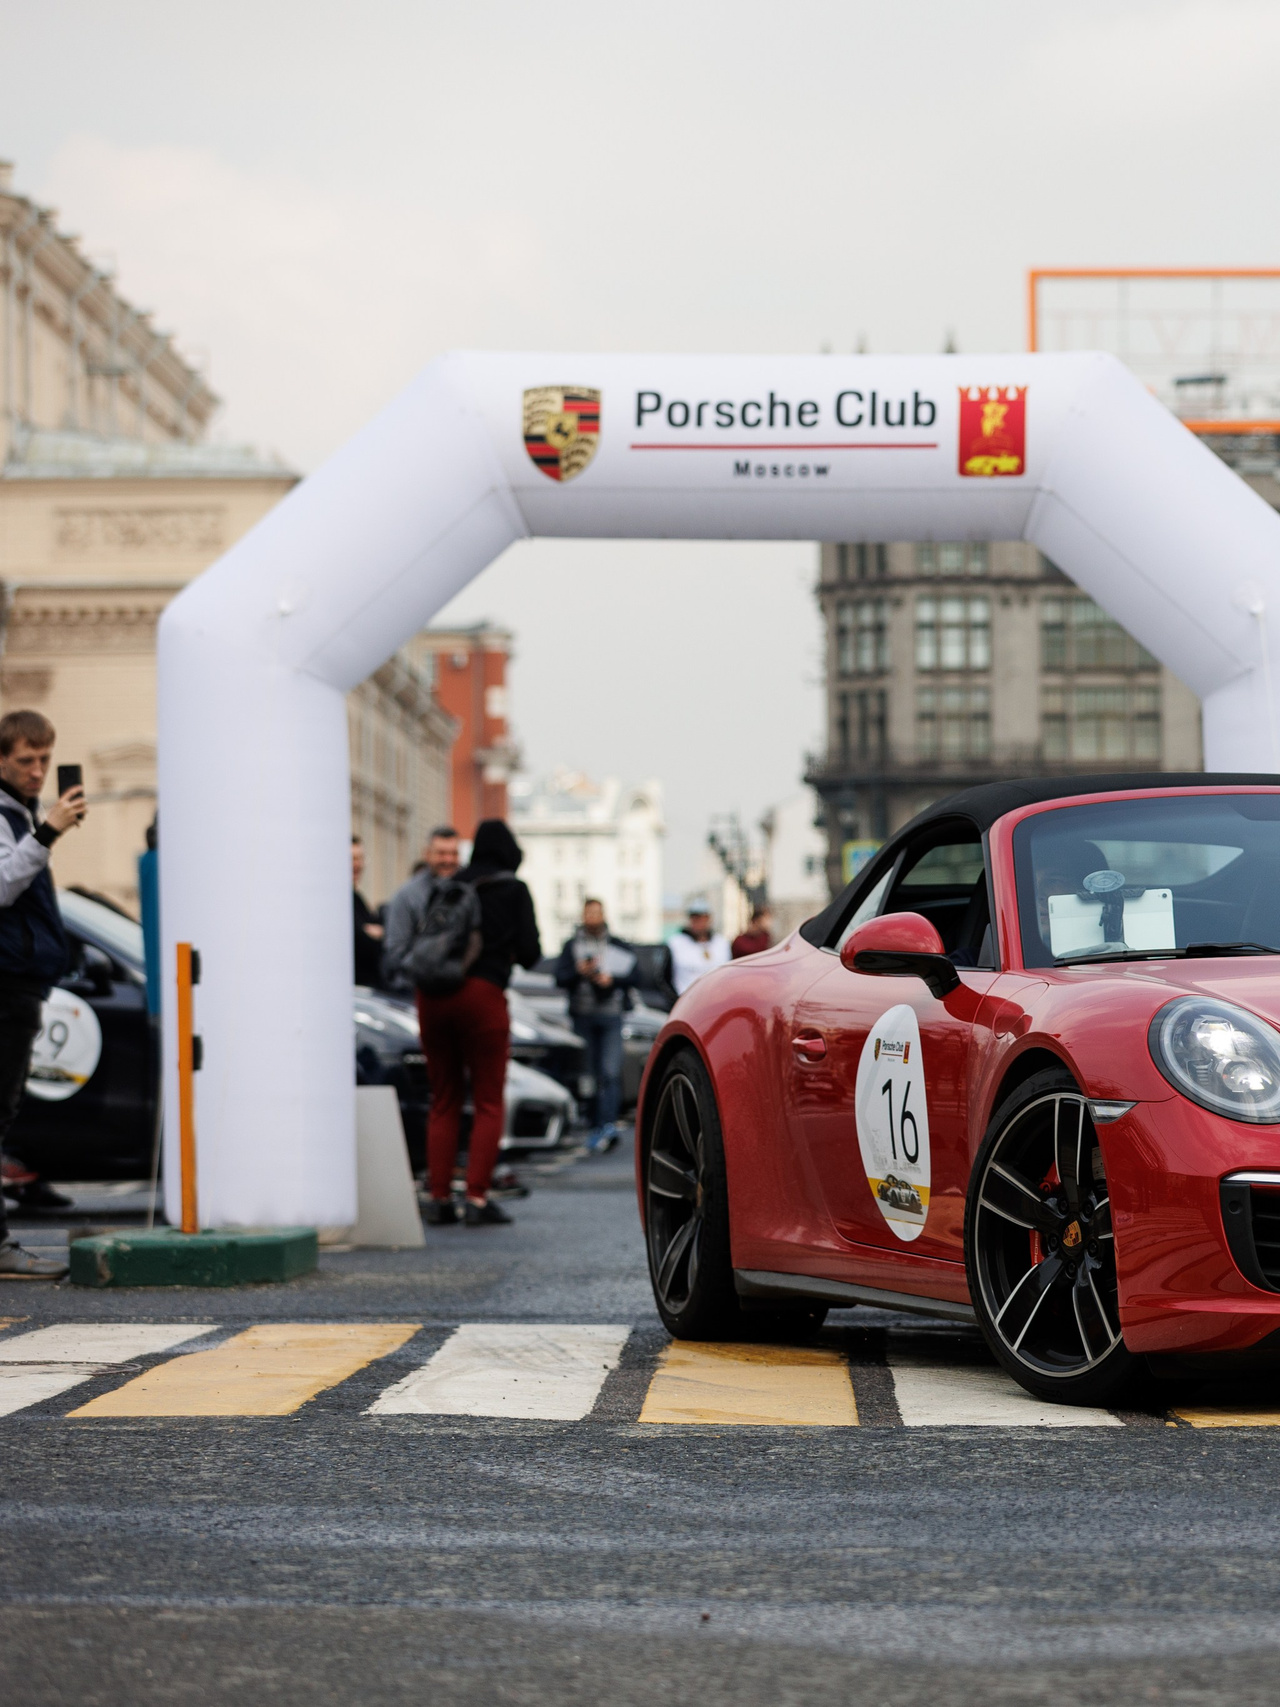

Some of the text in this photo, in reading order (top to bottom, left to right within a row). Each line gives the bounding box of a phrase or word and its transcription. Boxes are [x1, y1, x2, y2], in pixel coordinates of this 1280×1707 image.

[635, 391, 937, 429] Porsche Club
[733, 460, 832, 479] Moscow
[881, 1079, 919, 1164] 16
